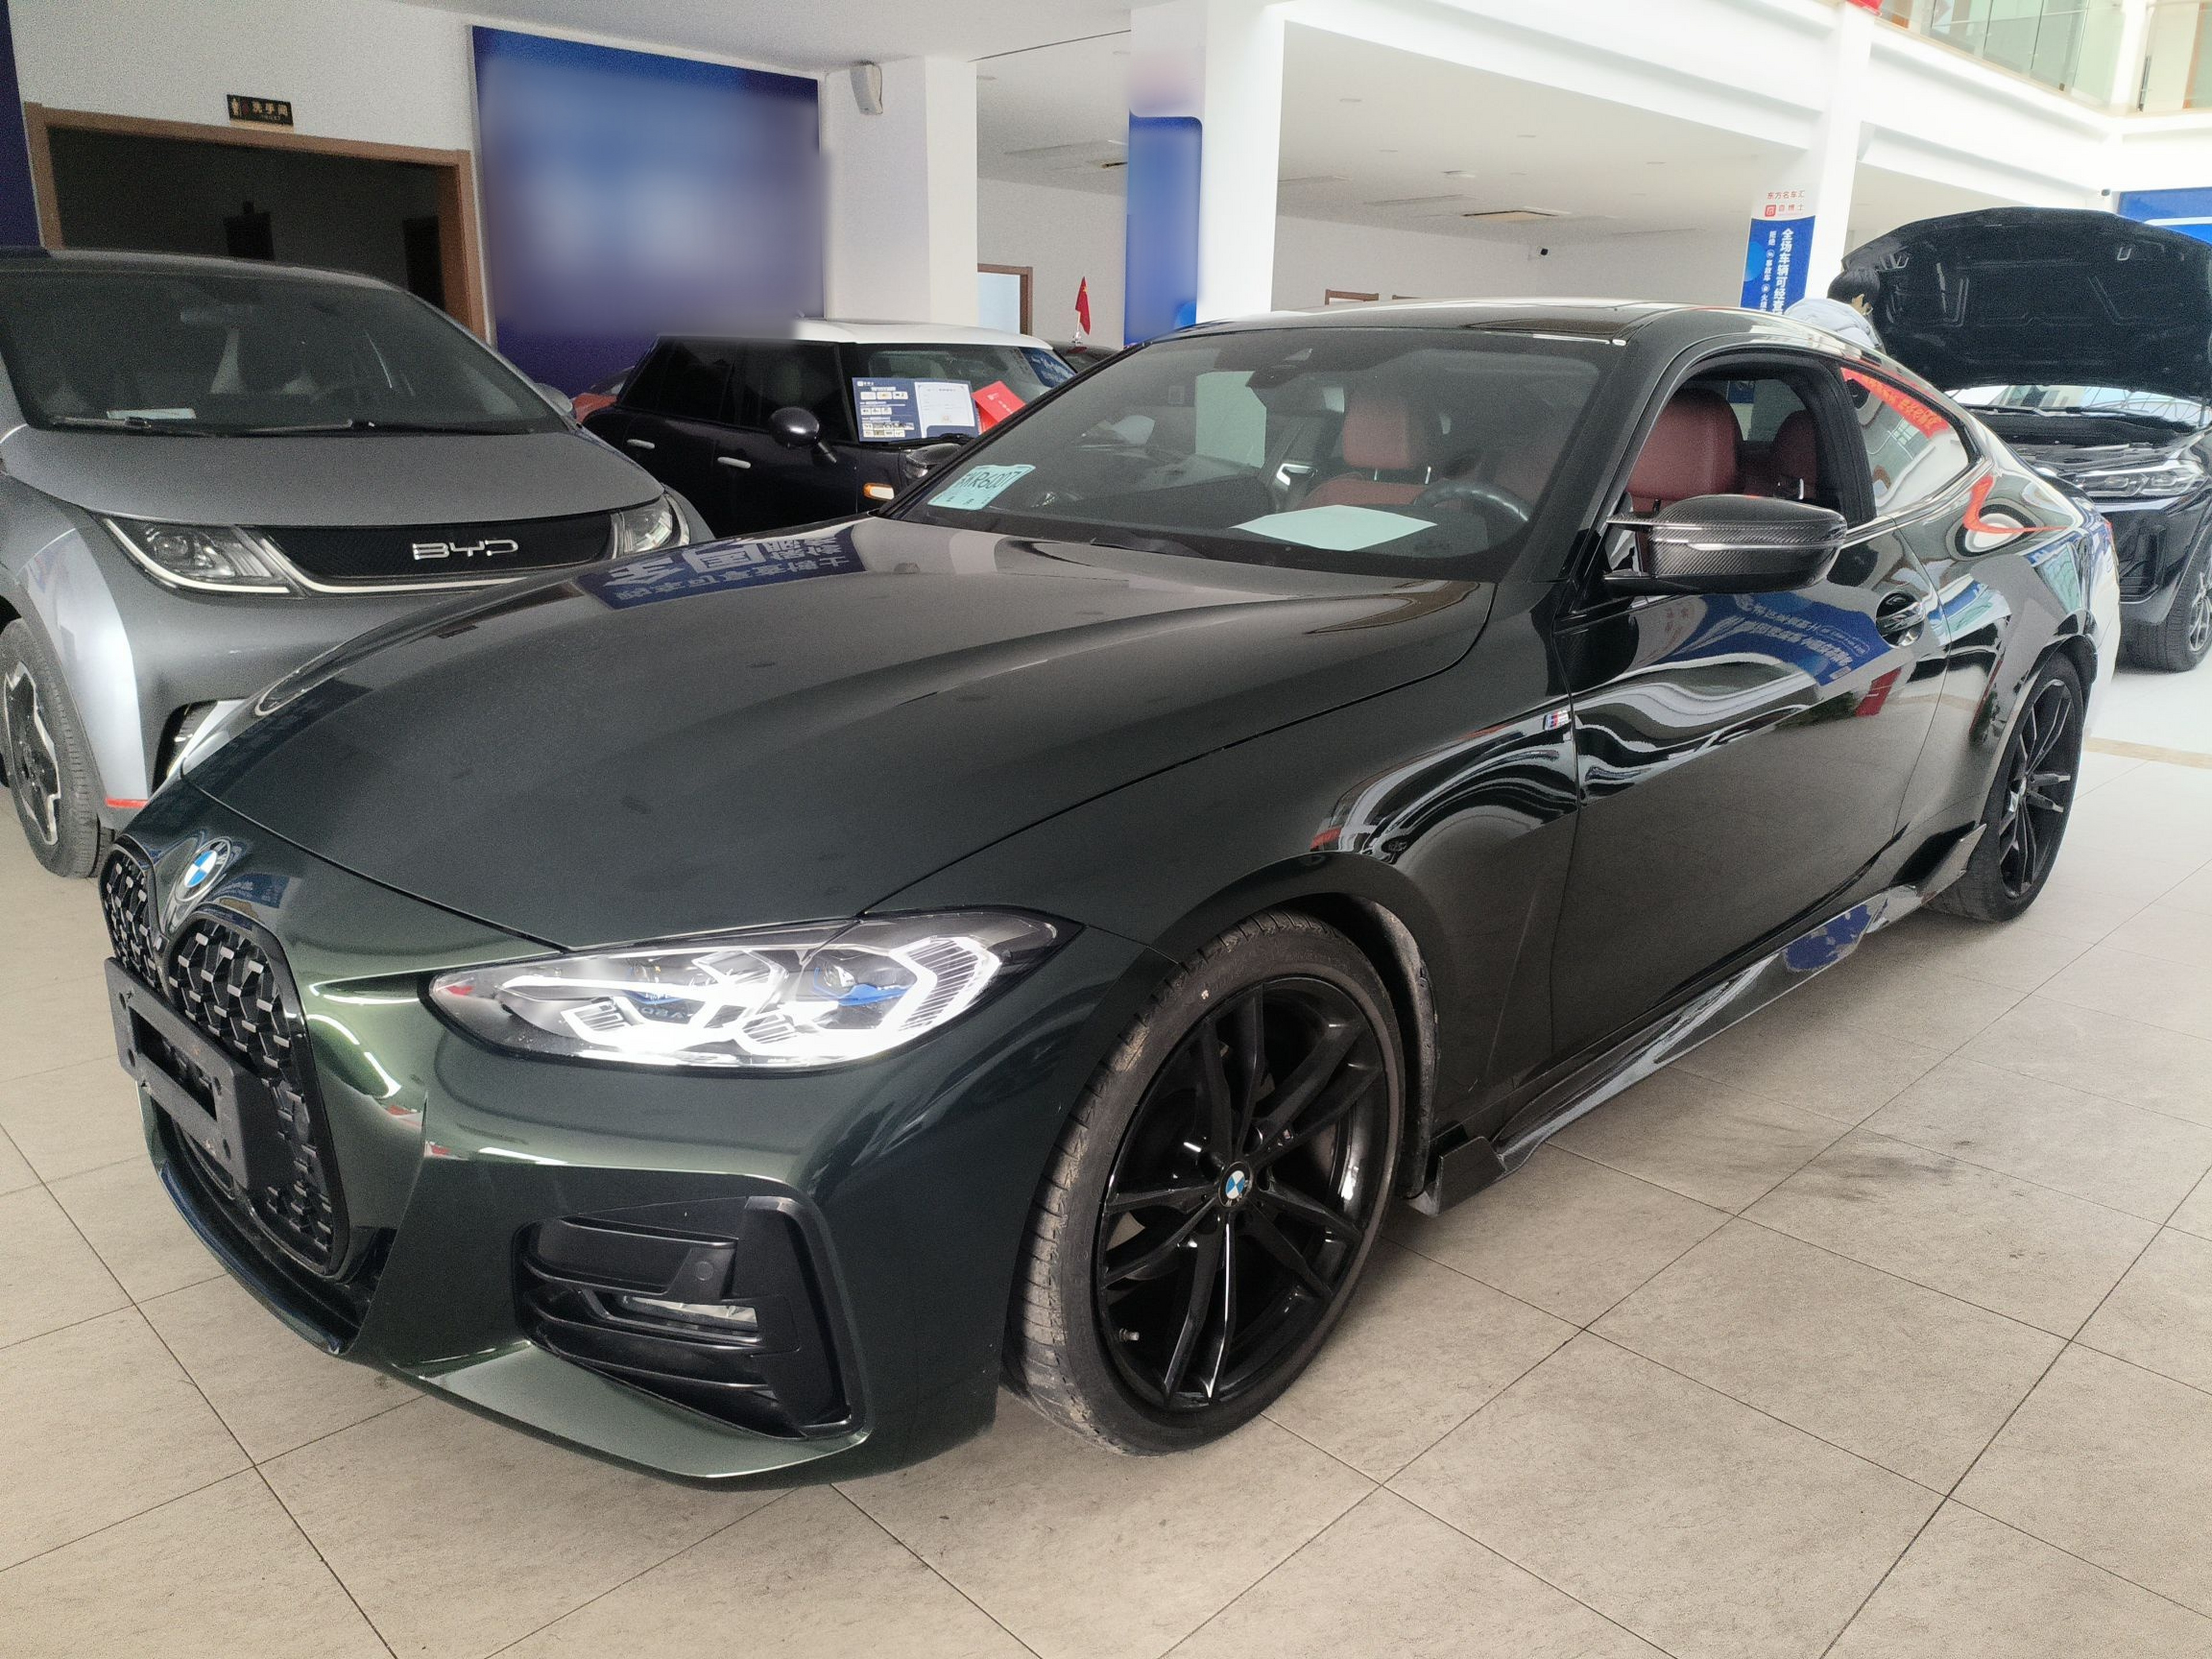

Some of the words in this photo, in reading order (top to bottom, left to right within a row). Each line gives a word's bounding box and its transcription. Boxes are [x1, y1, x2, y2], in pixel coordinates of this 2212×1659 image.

[1767, 190, 1805, 200] 东方名车汇
[1772, 228, 1794, 315] 全场车辆可经查
[412, 539, 518, 560] BYD
